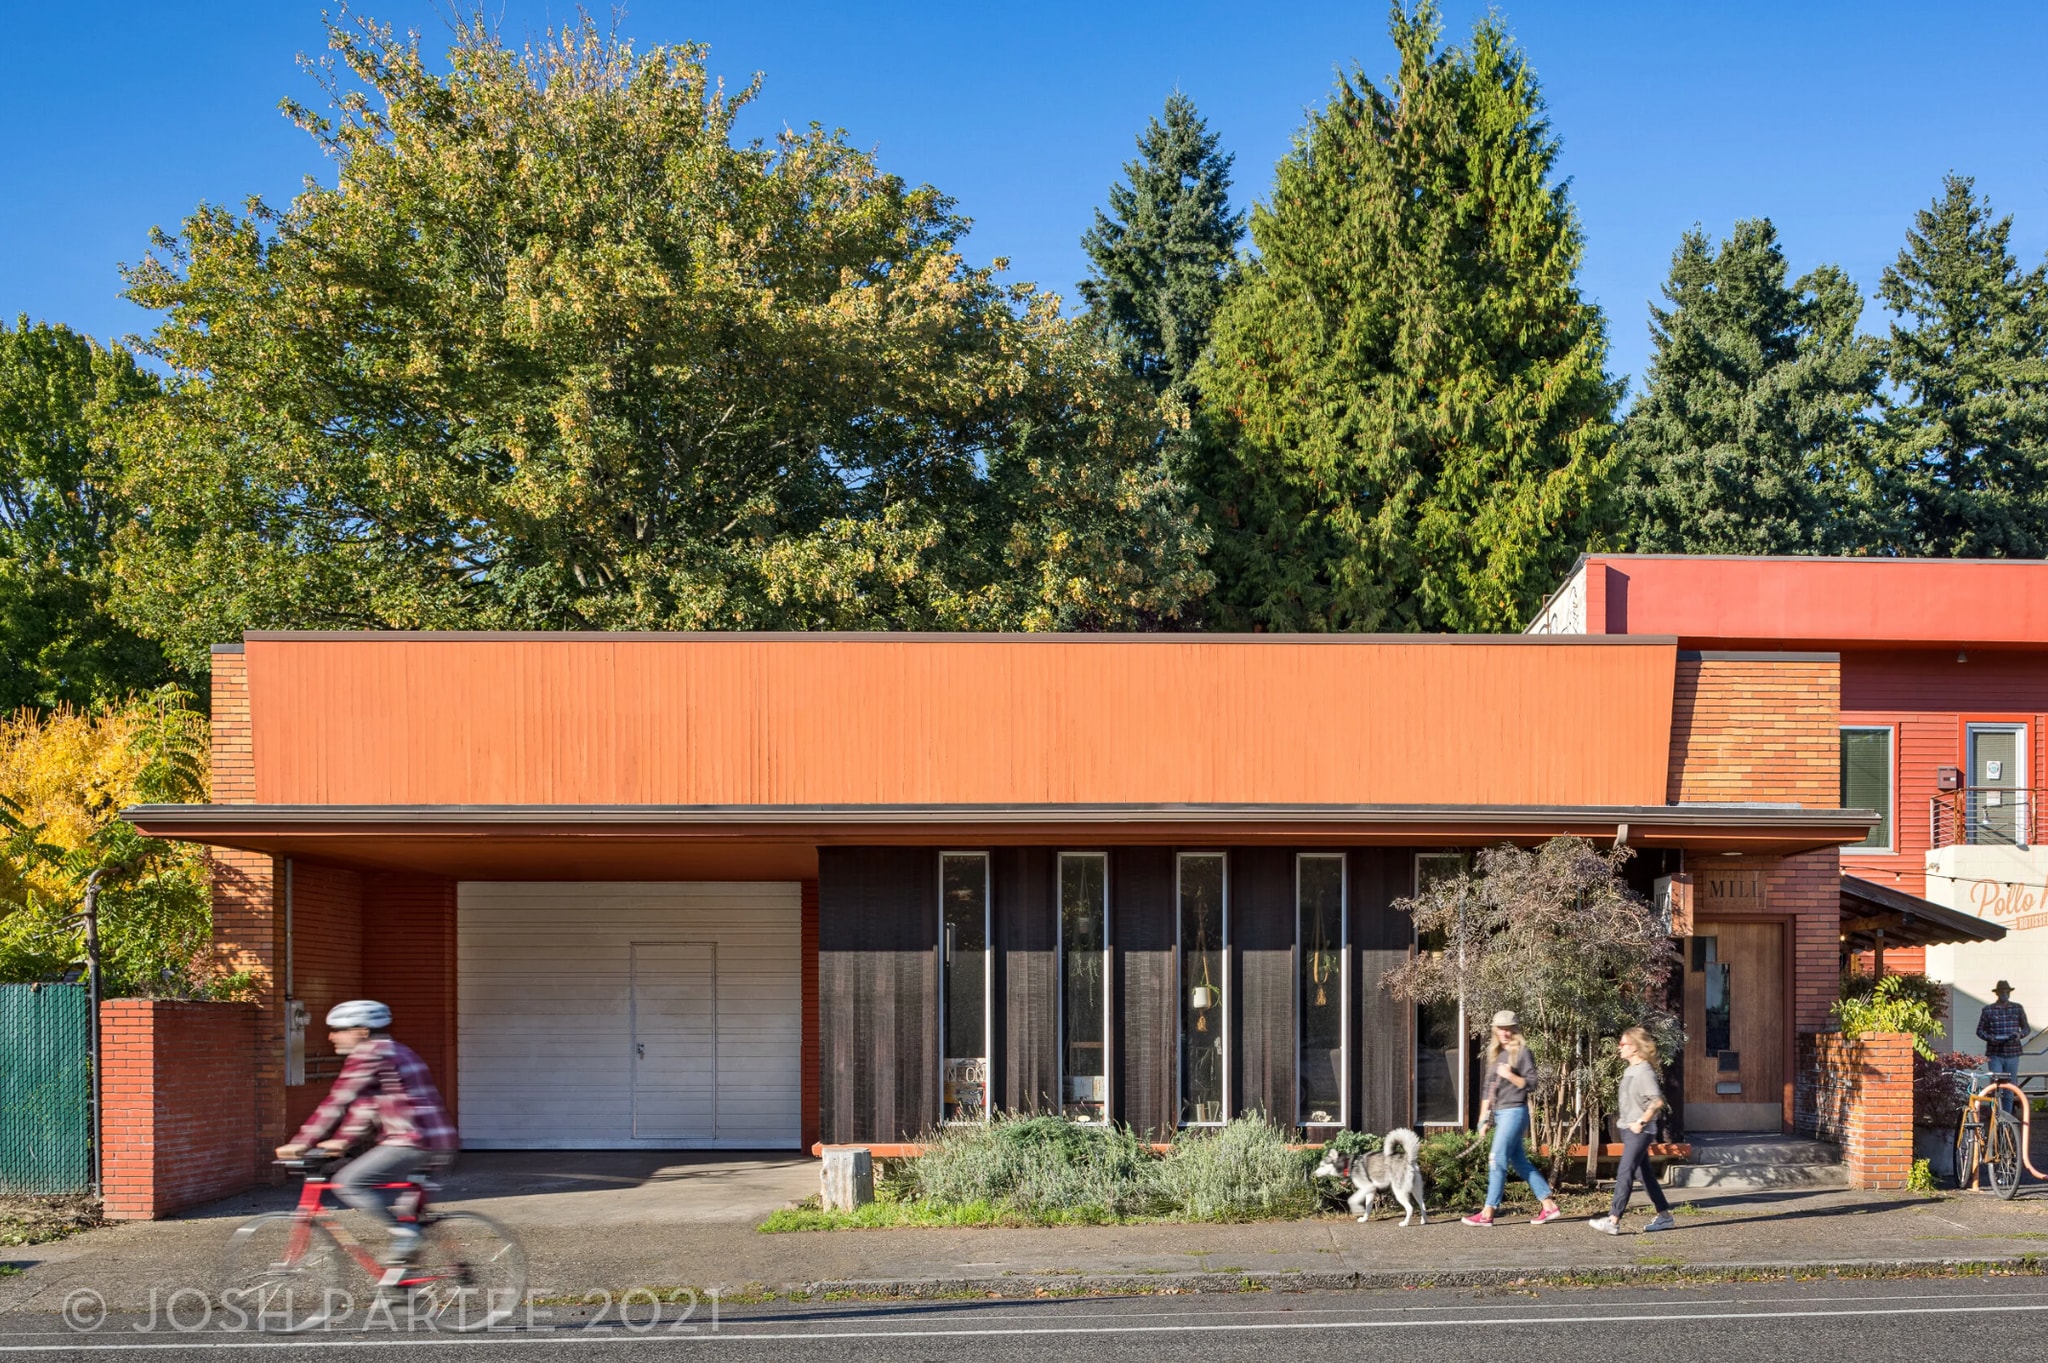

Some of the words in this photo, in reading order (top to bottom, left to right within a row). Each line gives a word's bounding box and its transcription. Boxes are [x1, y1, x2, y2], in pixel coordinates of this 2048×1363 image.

[1708, 880, 1764, 898] MILL
[1970, 878, 2036, 917] Pollo
[2019, 914, 2048, 929] ROTISSE
